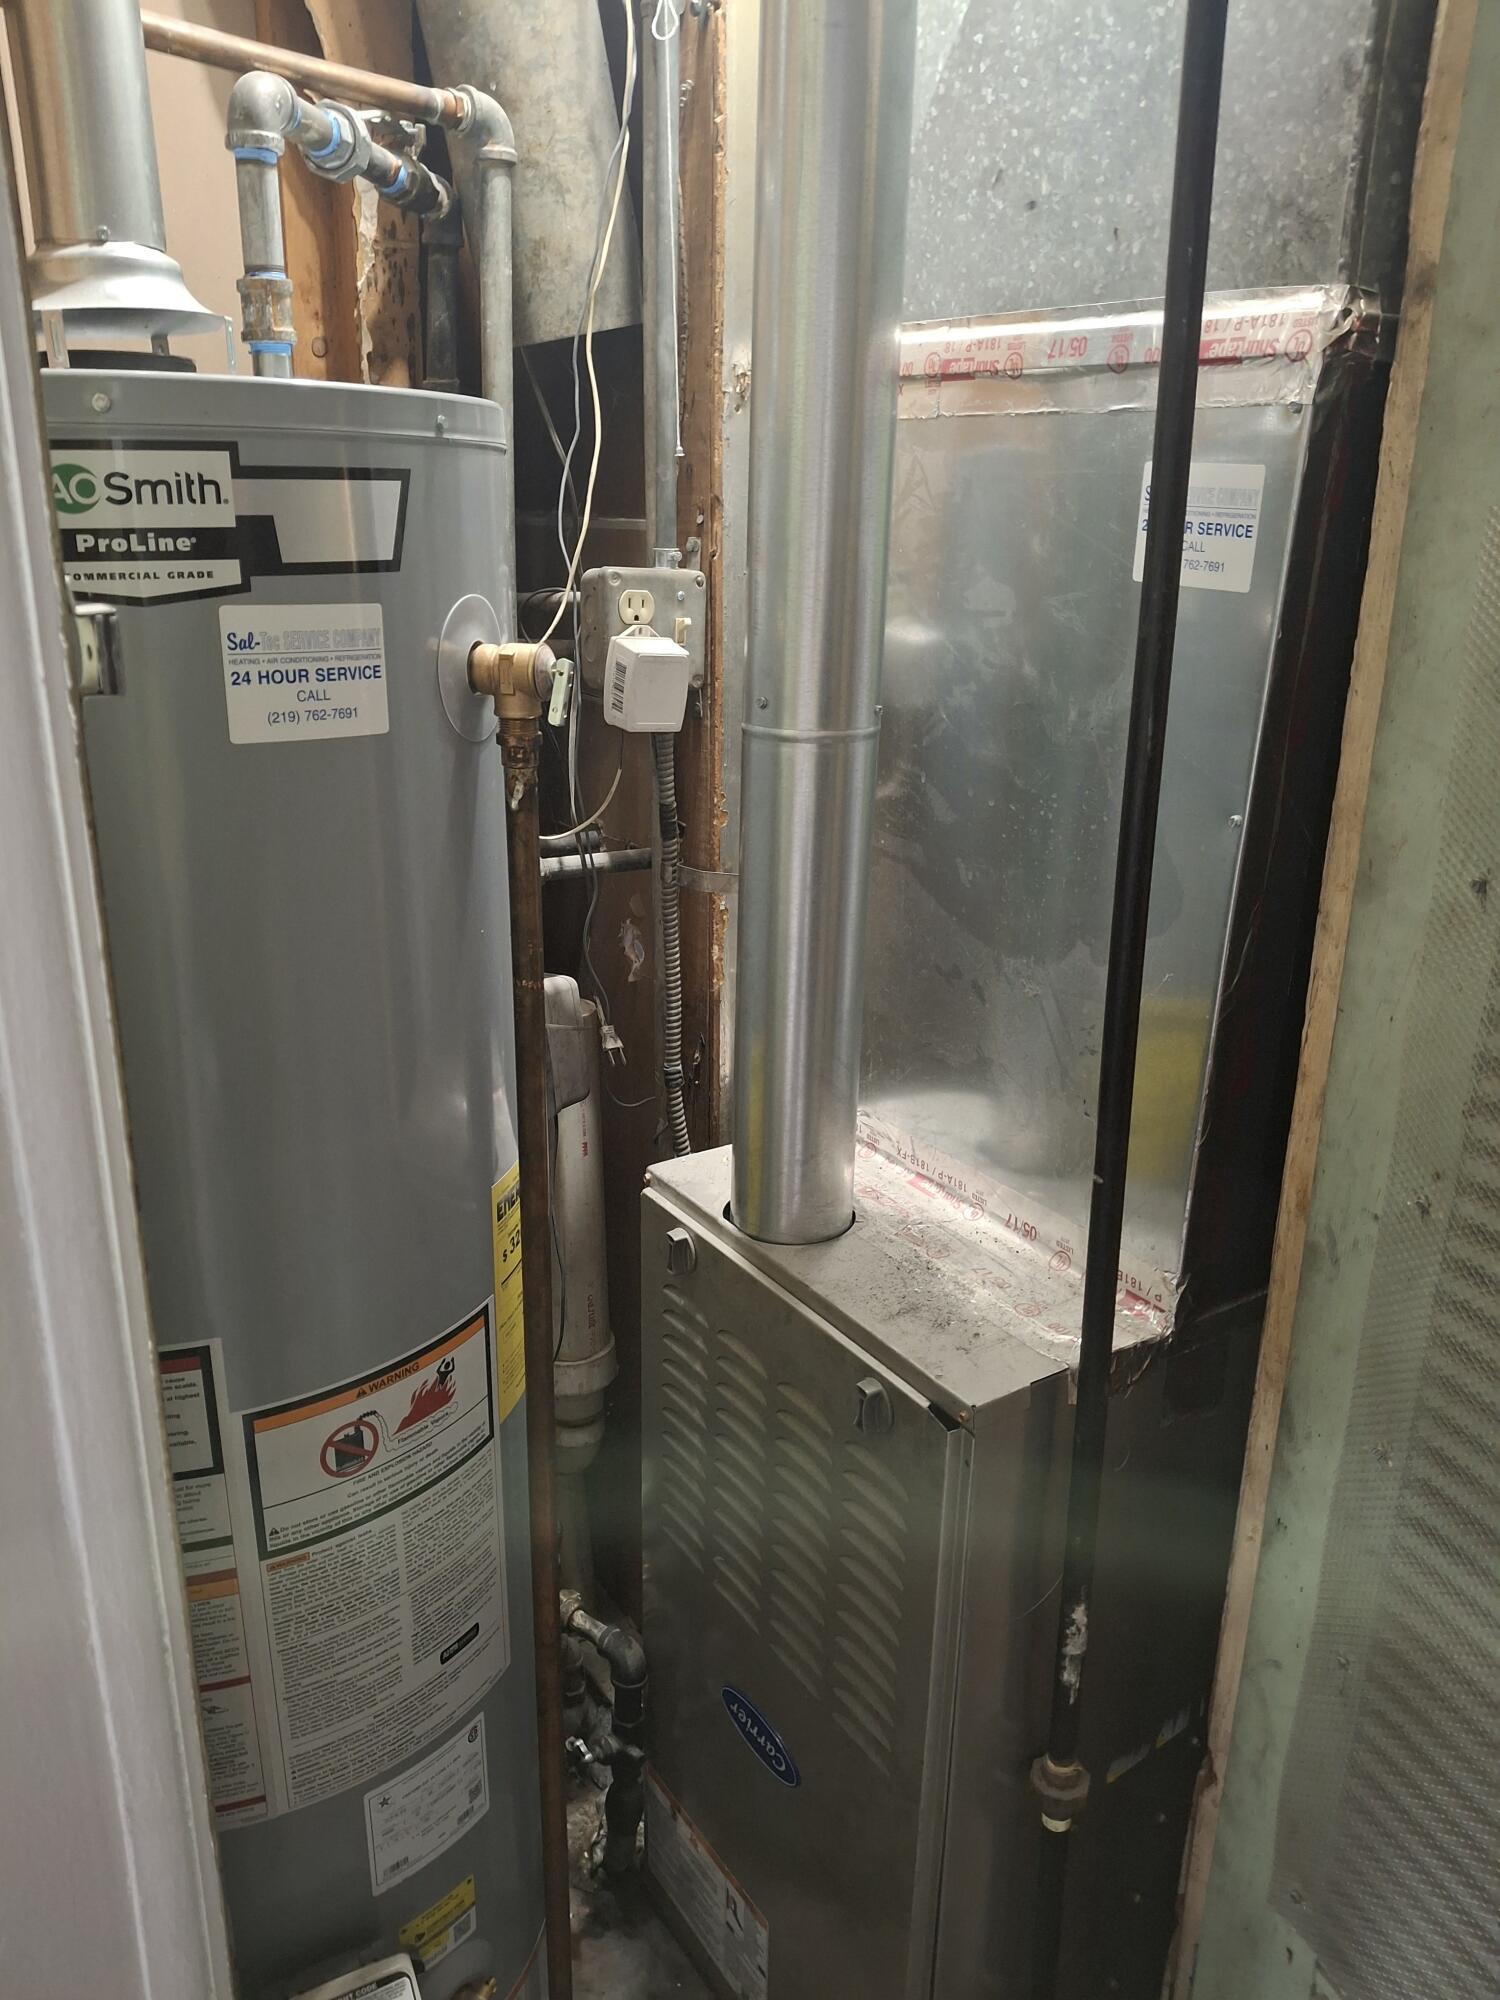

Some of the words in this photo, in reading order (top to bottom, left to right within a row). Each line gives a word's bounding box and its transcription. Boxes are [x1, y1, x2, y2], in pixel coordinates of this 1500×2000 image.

[1047, 336, 1088, 361] 05/17
[104, 471, 222, 506] Smith
[1197, 522, 1254, 539] SERVICE
[75, 532, 192, 553] ProLine
[65, 571, 160, 581] OMMERCIAL
[167, 571, 214, 579] GRADE
[1183, 559, 1225, 573] 762-7691
[228, 657, 261, 666] HEATING
[280, 655, 330, 665] CONDITIONING
[230, 671, 251, 686] 24
[258, 668, 310, 685] HOUR
[315, 664, 382, 683] SERVICE
[296, 690, 331, 702] CALL
[267, 711, 300, 727] (219)
[304, 706, 359, 722] 762-7691
[1004, 1214, 1038, 1242] 05/17
[368, 1362, 420, 1392] WARNING
[729, 1702, 787, 1772] Carrier
